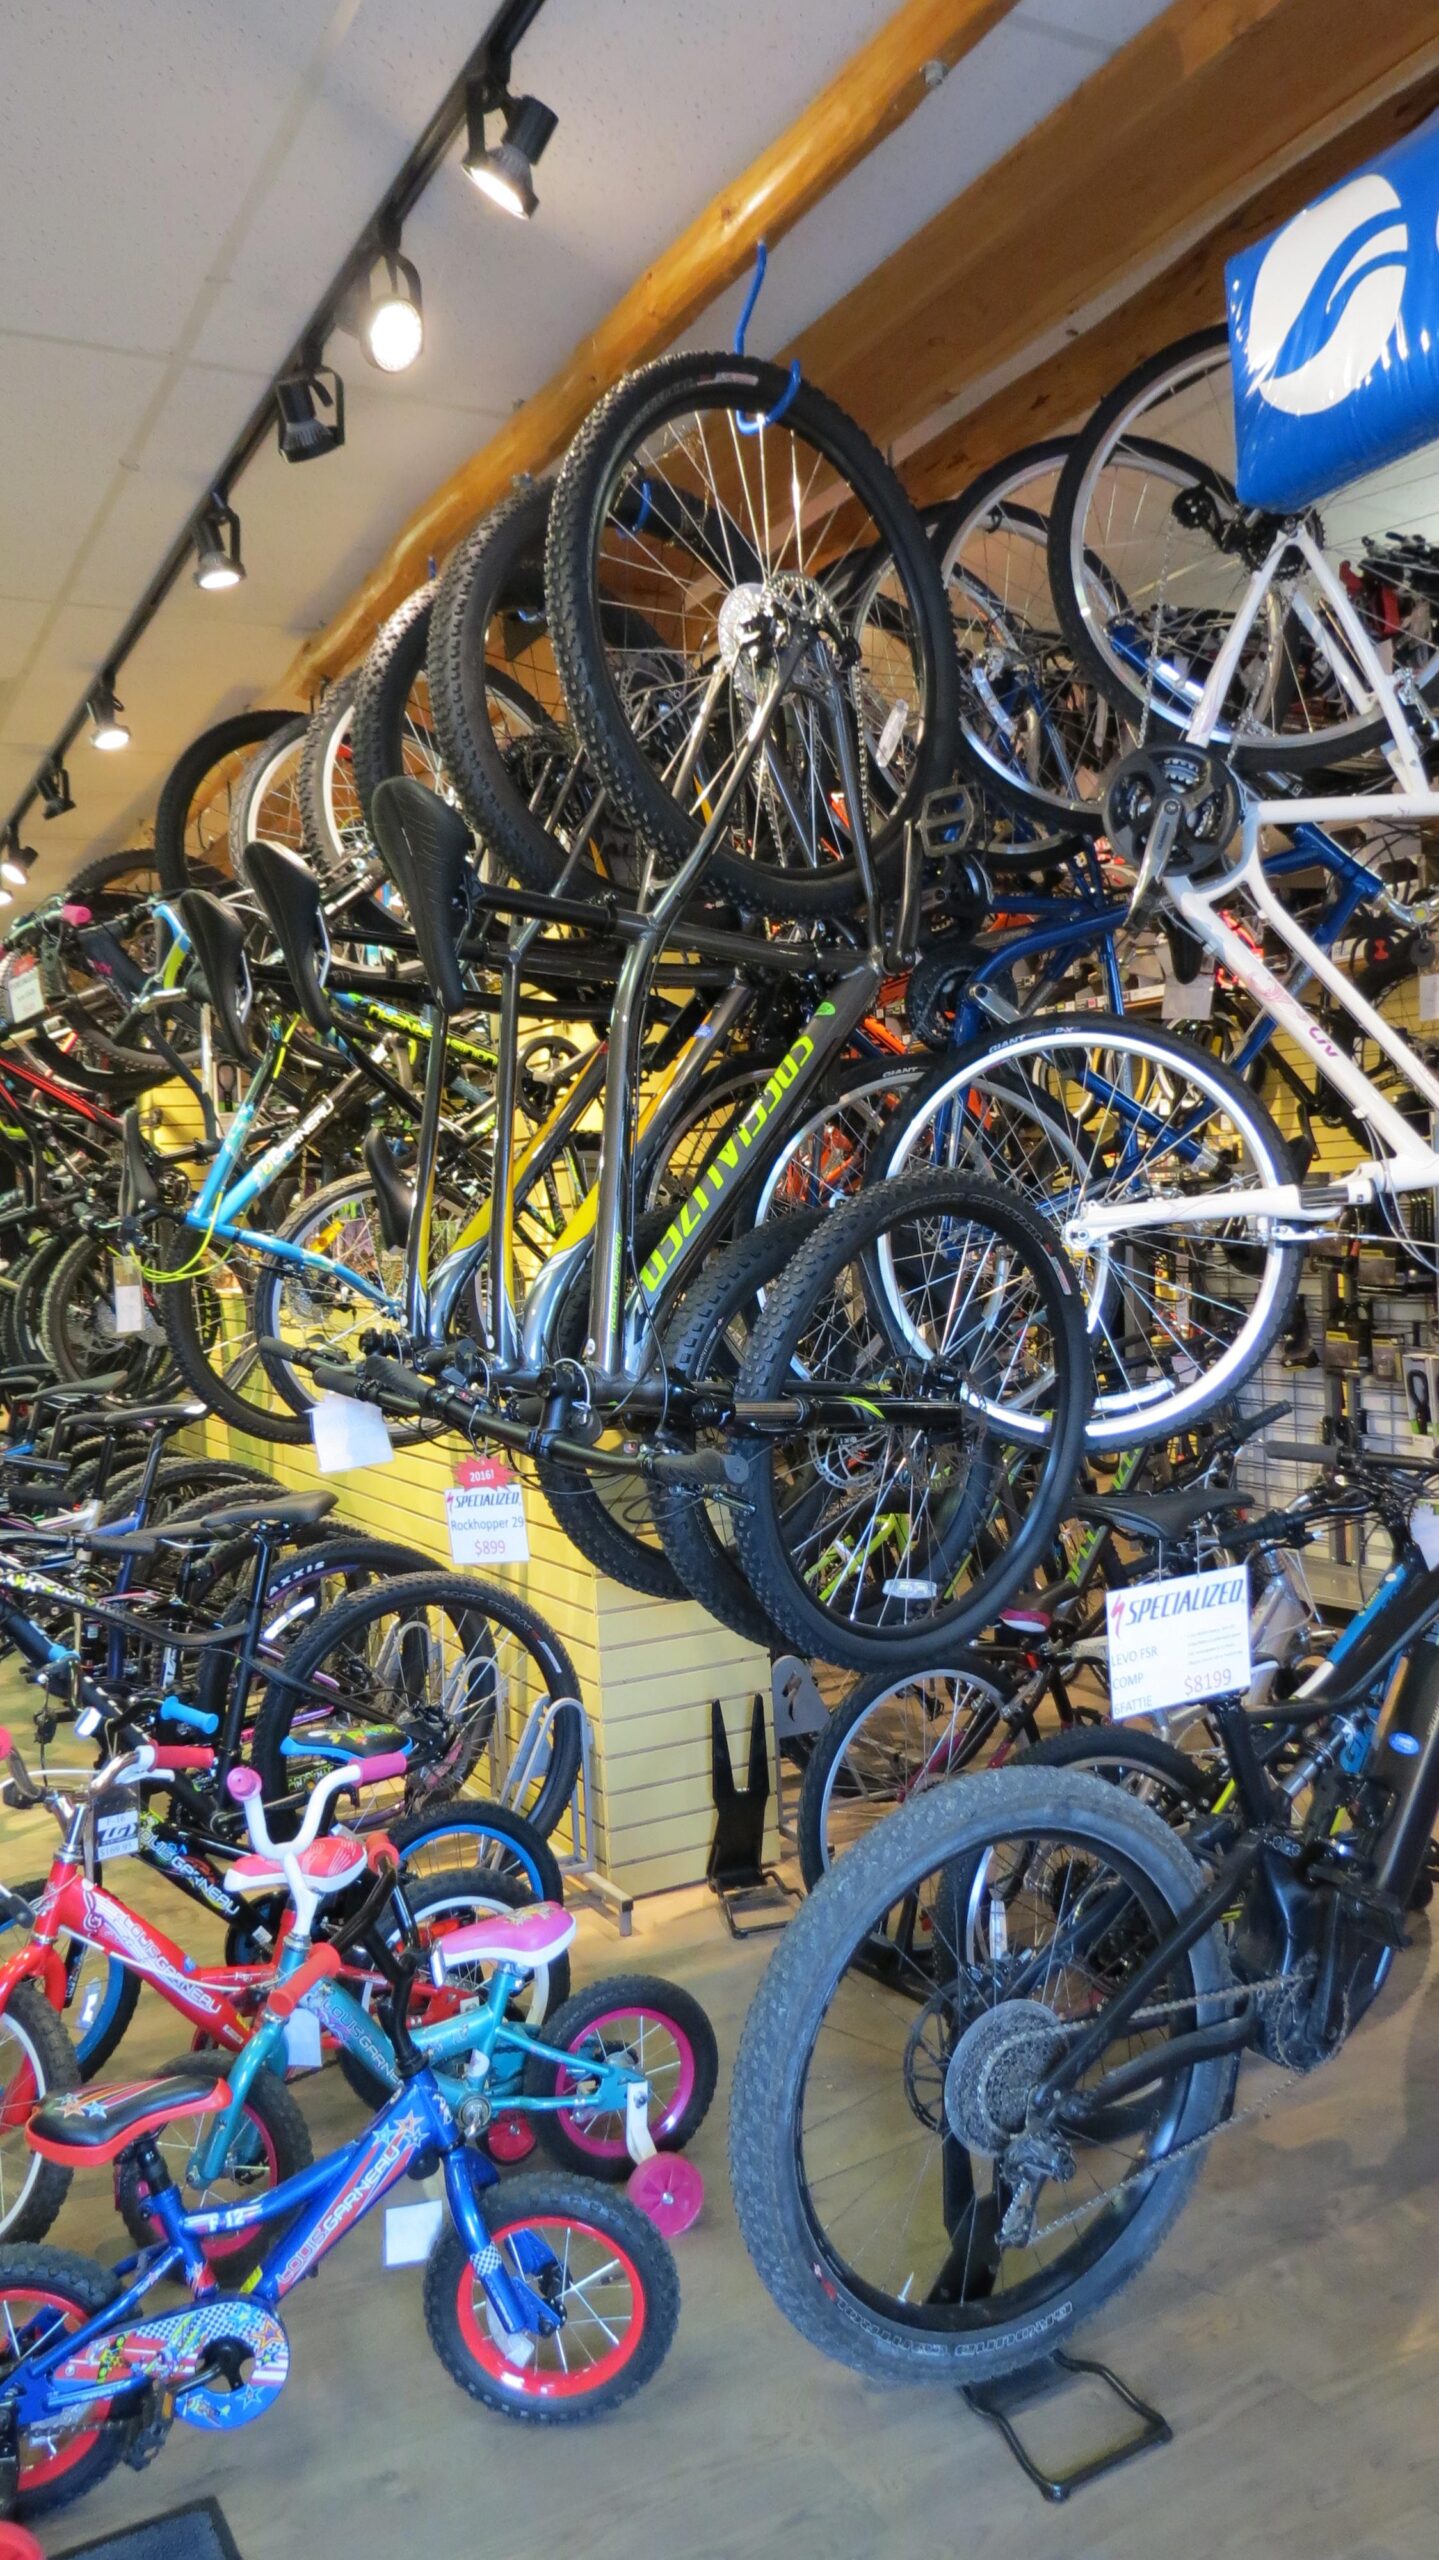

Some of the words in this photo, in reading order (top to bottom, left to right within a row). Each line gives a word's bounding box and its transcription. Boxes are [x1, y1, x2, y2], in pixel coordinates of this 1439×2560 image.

[989, 1033, 1027, 1054] GIANT
[882, 1065, 919, 1079] GIANT
[469, 1468, 495, 1483] 2016!
[456, 1491, 520, 1508] SPECIALIZED
[450, 1517, 509, 1532] Rockhopper
[512, 1515, 525, 1528] 29
[474, 1539, 507, 1557] $899
[268, 1560, 325, 1598] AXXIS
[1125, 1578, 1244, 1627] SPECIALIZED
[1111, 1650, 1138, 1667] LEVO
[1139, 1645, 1158, 1659] FSR
[1112, 1672, 1144, 1691] COMP
[1183, 1667, 1232, 1697] $8199
[170, 1854, 240, 1915] GARNEAU
[122, 1914, 163, 1962] LOUIS
[155, 1955, 222, 2014] GARNEAU
[321, 1999, 363, 2041] LOUIS
[322, 2144, 401, 2234] GARNEAU
